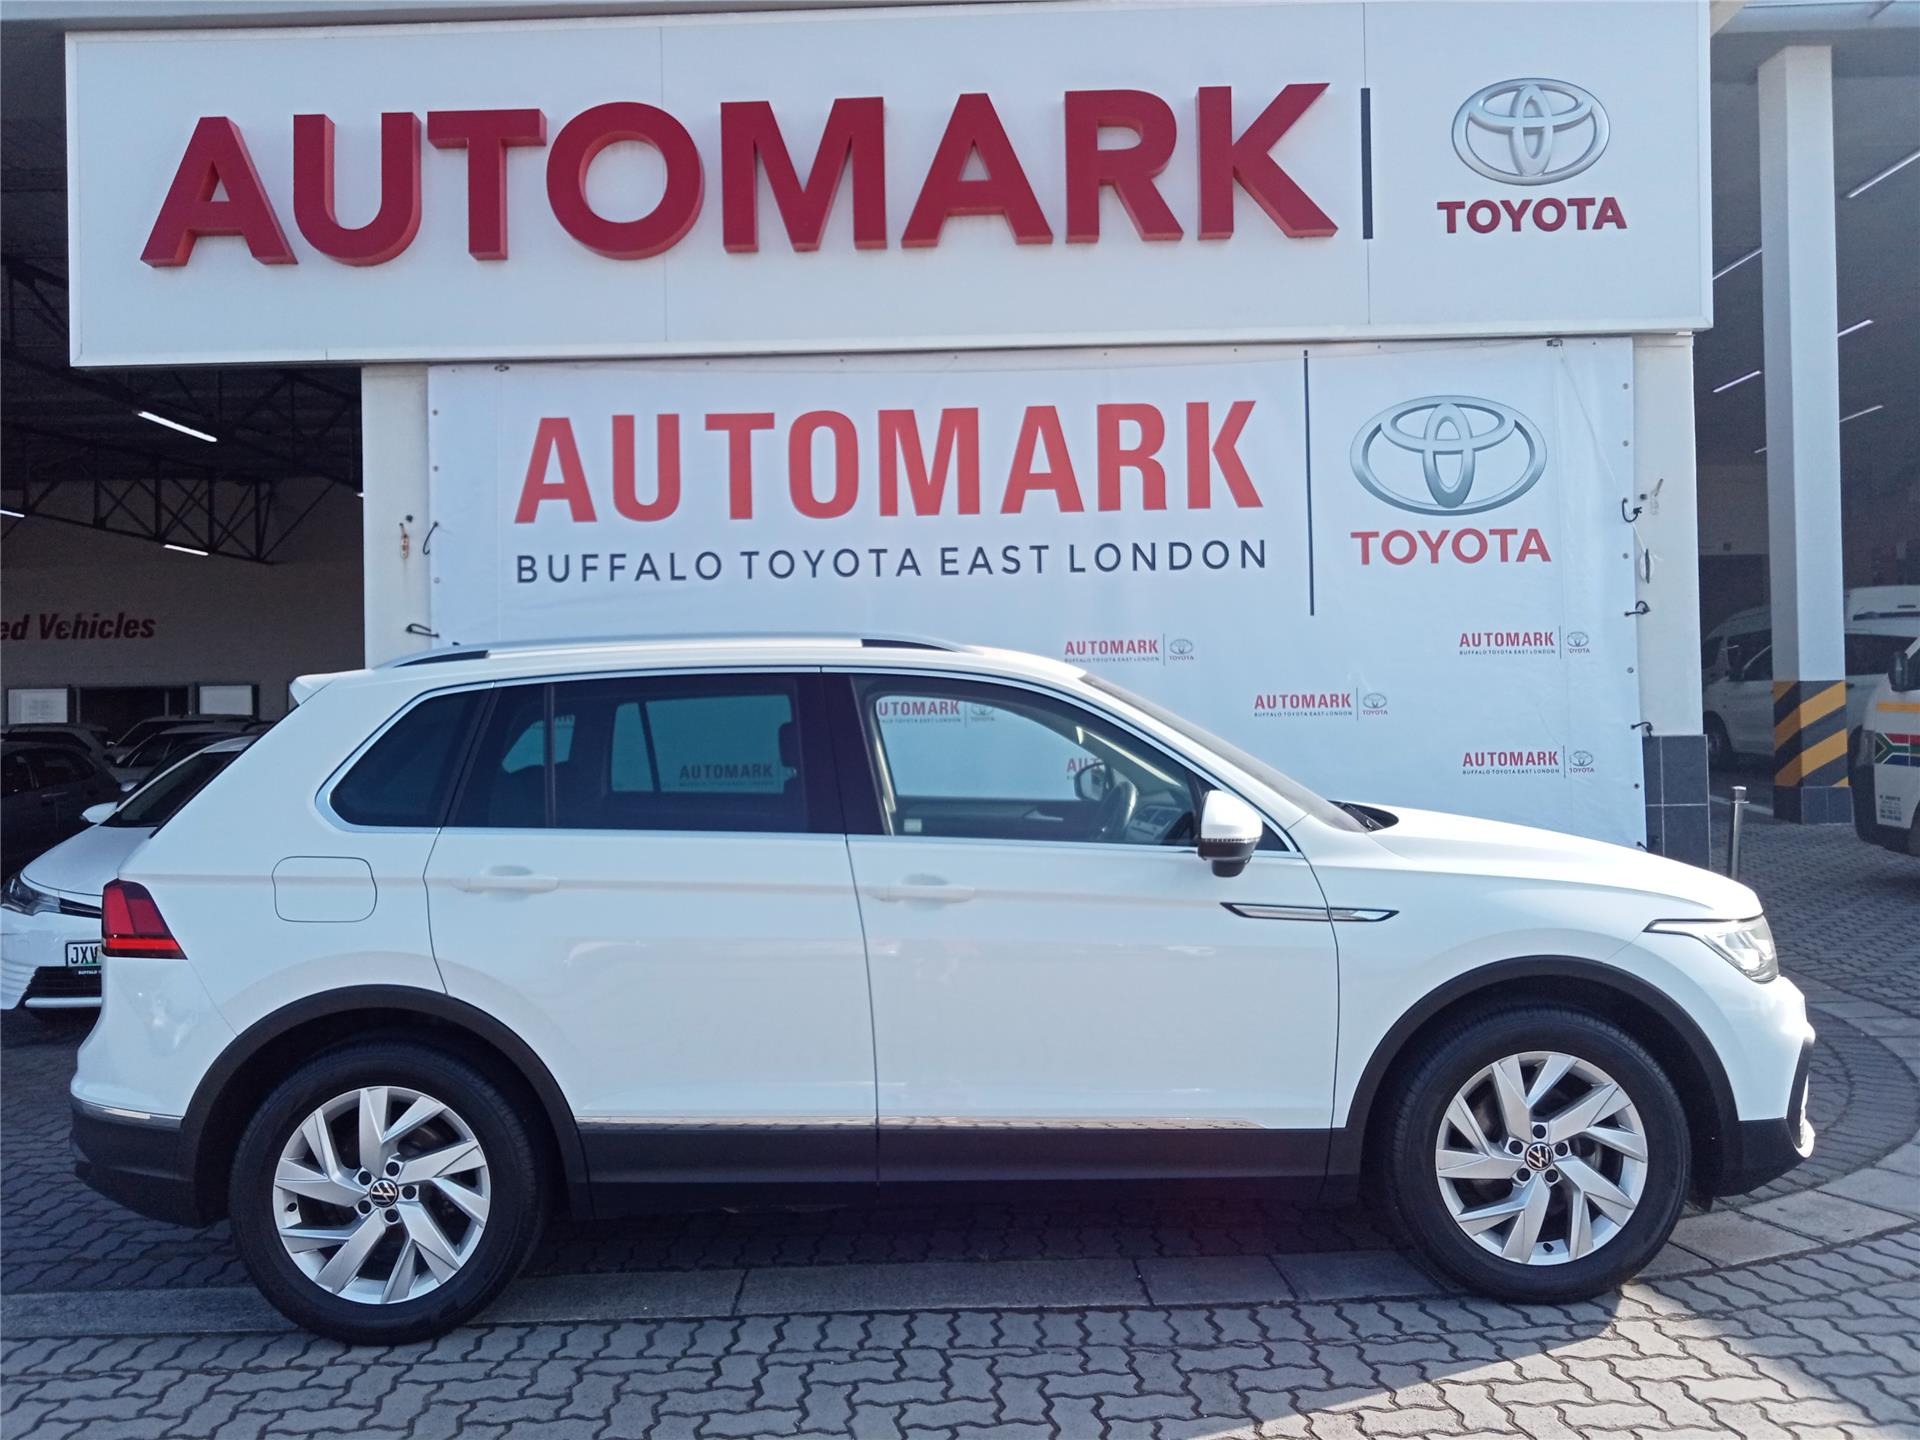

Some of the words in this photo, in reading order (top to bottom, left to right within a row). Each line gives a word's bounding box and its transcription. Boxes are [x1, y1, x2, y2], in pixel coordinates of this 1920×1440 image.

[144, 84, 1335, 266] AUTOMARK
[1438, 197, 1627, 233] TOYOTA
[515, 401, 1261, 523] AUTOMARK
[1352, 528, 1551, 565] TOYOTA
[517, 552, 722, 583] BUFFALO
[739, 548, 922, 580] TOYOTA
[941, 545, 1050, 576] EAST
[1069, 540, 1265, 573] LONDON
[39, 612, 156, 640] Vehicles
[1064, 639, 1159, 656] AUTOMARK
[1459, 631, 1555, 647] AUTOMARK
[879, 700, 960, 717] UTOMARK
[1254, 692, 1352, 710] AUTOMARK
[1463, 751, 1559, 767] AUTOMARK
[680, 763, 773, 780] AUTOMARK
